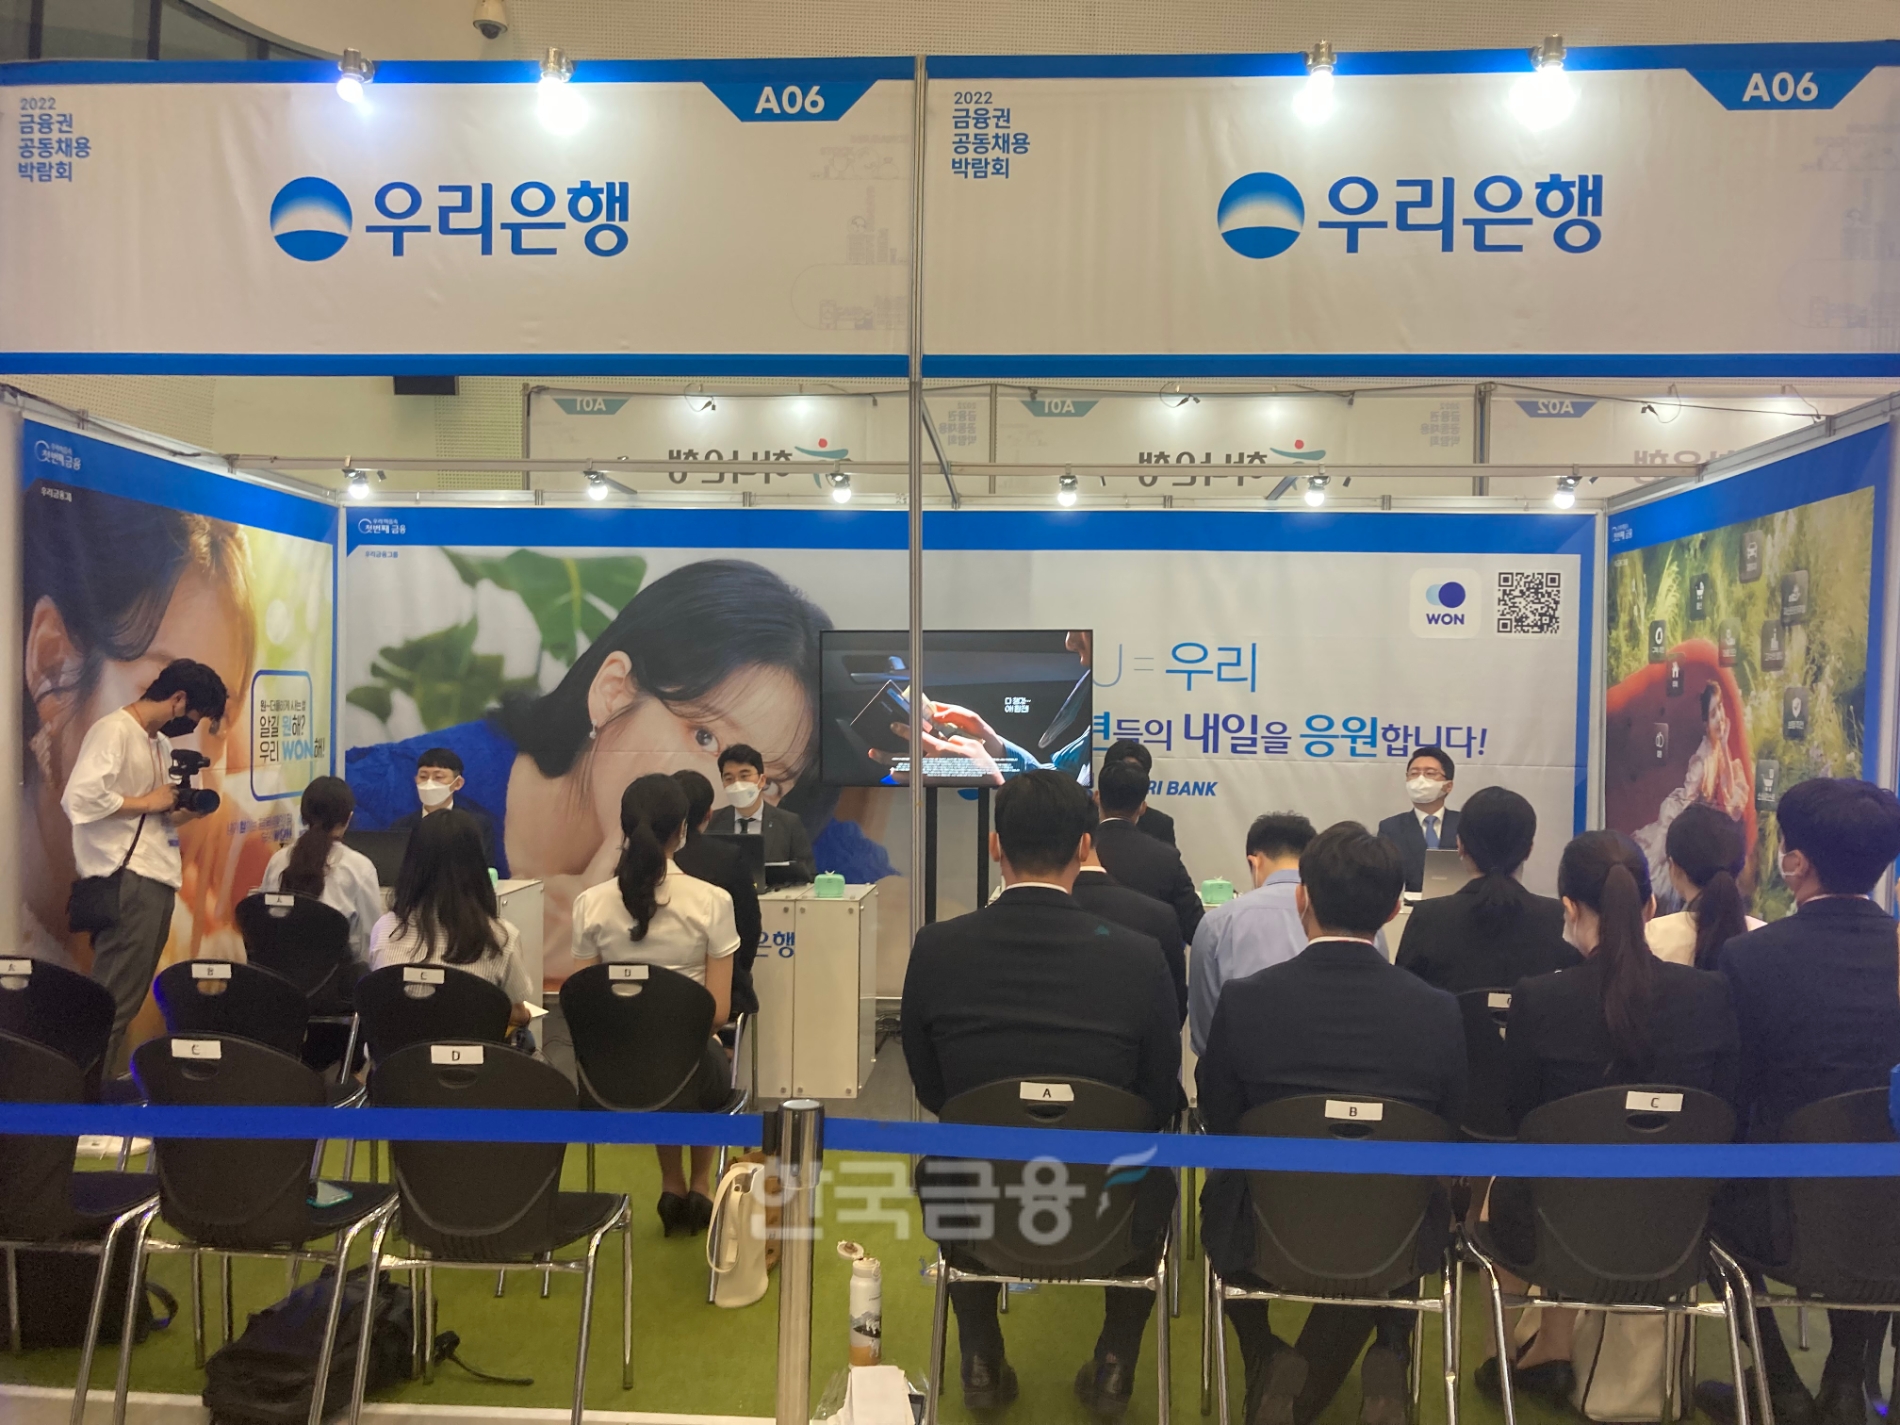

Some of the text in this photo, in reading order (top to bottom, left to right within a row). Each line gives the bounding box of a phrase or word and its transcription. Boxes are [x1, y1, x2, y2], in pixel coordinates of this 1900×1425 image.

[1742, 72, 1819, 102] A06
[19, 97, 57, 111] 2022
[754, 85, 826, 115] A06
[953, 91, 994, 105] 2022
[18, 114, 74, 134] 금융권
[952, 108, 1012, 130] 금융권
[18, 137, 91, 159] 공동채용
[951, 132, 1031, 155] 공동채용
[18, 161, 73, 182] 박람회
[951, 157, 1011, 180] 박람회
[365, 180, 630, 257] 우리은행
[1318, 173, 1604, 254] 우리은행
[391, 524, 406, 534] 금융
[1426, 613, 1465, 625] WON
[1165, 642, 1257, 693] 우리
[1184, 713, 1292, 755] 내일을
[1299, 714, 1487, 759] 응원합니다!
[259, 740, 279, 763] 우리
[1166, 781, 1218, 797] BANK
[451, 1050, 461, 1062] D
[1042, 1087, 1052, 1099] A
[1650, 1097, 1660, 1109] C
[1349, 1106, 1358, 1117] B
